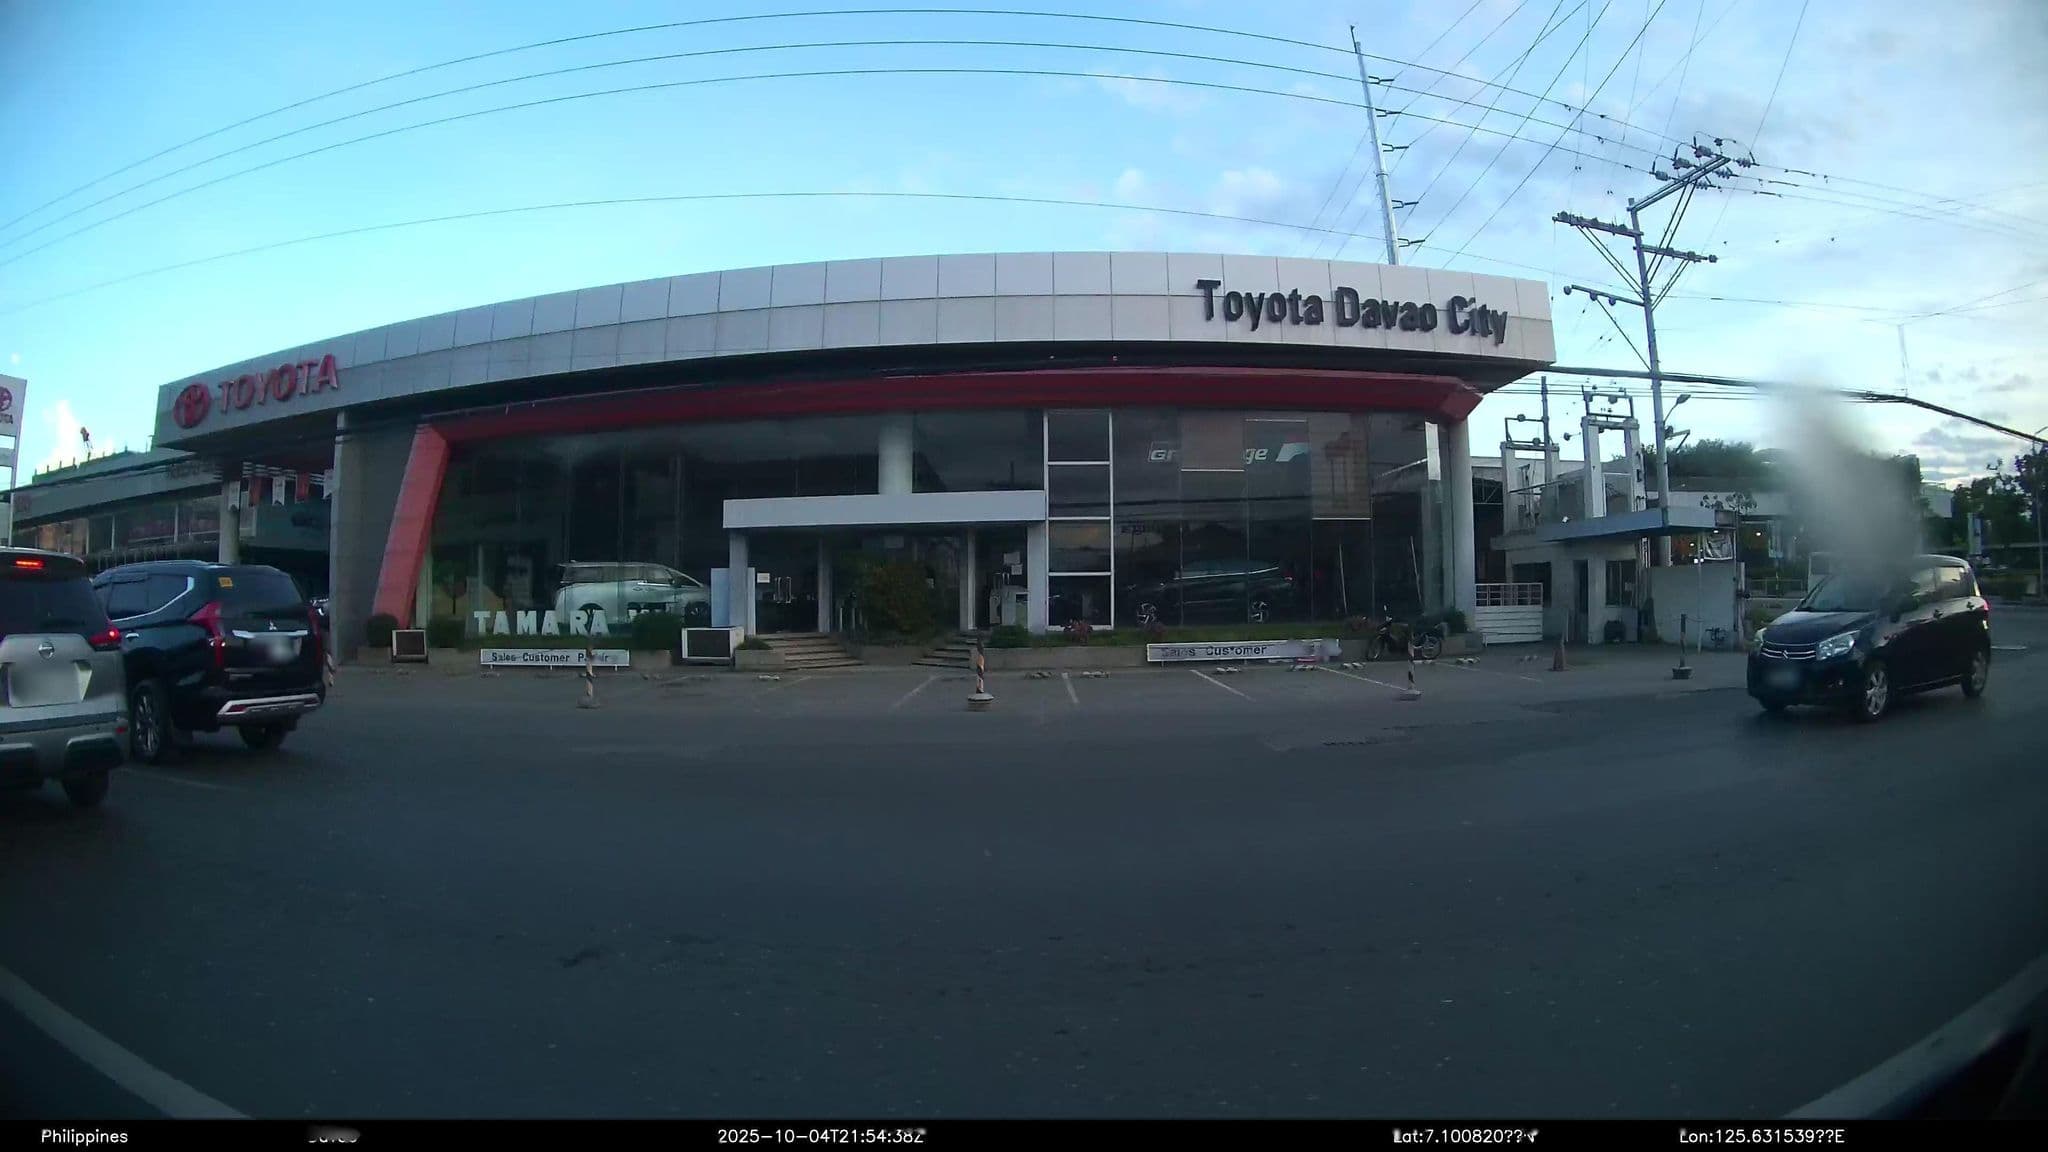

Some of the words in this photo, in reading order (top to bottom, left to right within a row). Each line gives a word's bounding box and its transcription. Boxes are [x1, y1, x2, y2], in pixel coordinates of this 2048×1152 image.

[1198, 279, 1324, 331] Toyota
[1335, 286, 1437, 332] Davao
[1447, 295, 1508, 346] City
[218, 353, 338, 413] TOYOTA
[522, 652, 570, 662] Customer
